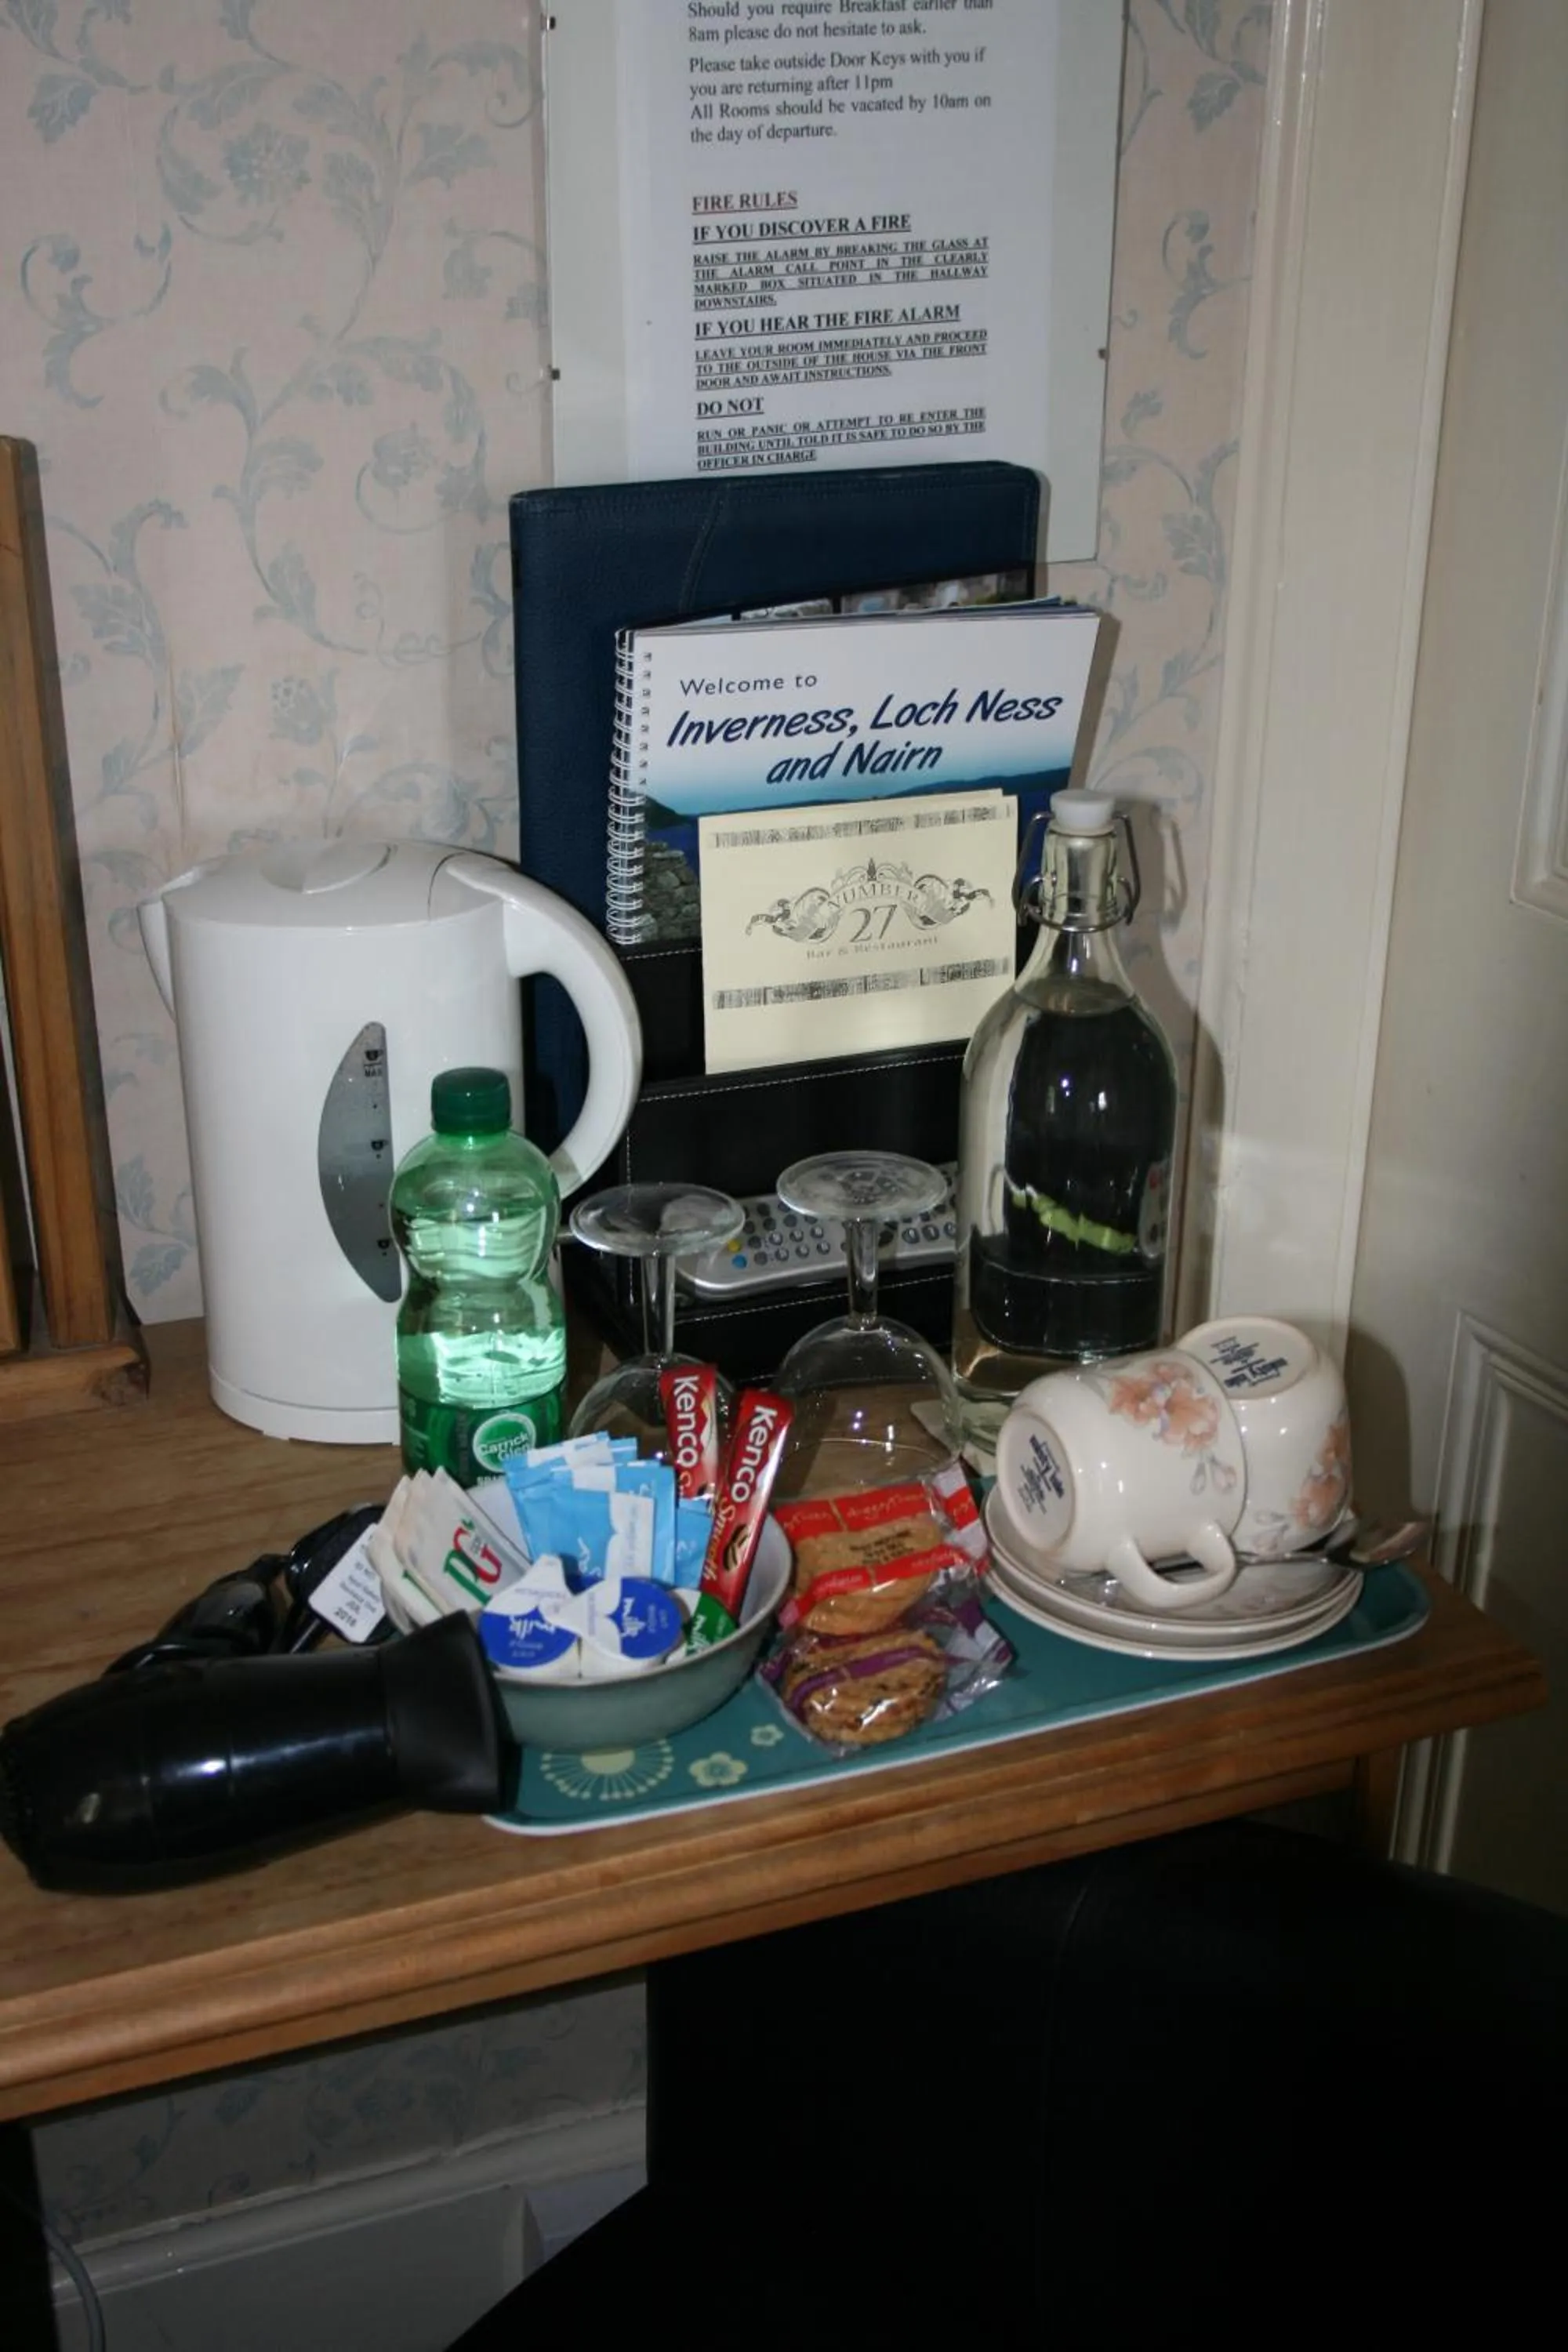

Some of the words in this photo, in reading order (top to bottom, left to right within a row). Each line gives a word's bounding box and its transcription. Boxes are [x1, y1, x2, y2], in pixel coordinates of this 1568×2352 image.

[688, 2, 739, 17] Should
[747, 4, 774, 20] you
[782, 1, 833, 19] require
[840, 0, 906, 13] Breakfast
[689, 26, 719, 42] 8am
[724, 25, 769, 44] please
[774, 24, 791, 38] do
[797, 24, 818, 38] not
[823, 21, 877, 37] hesitate
[881, 22, 895, 35] to
[899, 18, 927, 34] ask.
[690, 57, 735, 72] Please
[740, 55, 770, 71] take
[774, 53, 826, 69] outside
[830, 52, 866, 68] Door
[870, 50, 906, 70] Keys
[910, 47, 940, 64] with
[944, 51, 970, 67] you
[975, 46, 986, 62] if
[690, 84, 717, 100] you
[721, 83, 742, 95] are
[747, 78, 812, 96] returning
[817, 75, 849, 92] after
[855, 74, 893, 93] 11pm
[691, 103, 713, 119] All
[720, 103, 770, 118] Rooms
[775, 99, 822, 115] should
[829, 98, 845, 113] be
[851, 96, 903, 112] vacated
[909, 94, 927, 113] by
[933, 93, 969, 109] 10am
[975, 95, 991, 107] on
[690, 127, 713, 143] the
[717, 125, 743, 145] day
[747, 124, 764, 140] of
[766, 122, 837, 143] departure.
[692, 194, 734, 212] FIRE
[739, 191, 798, 209] RULES
[693, 224, 710, 241] IF
[716, 223, 753, 240] YOU
[759, 217, 849, 236] DISCOVER
[855, 217, 866, 232] A
[872, 213, 911, 231] FIRE
[693, 252, 728, 266] RAISE
[735, 251, 760, 263] THE
[767, 247, 809, 261] ALARM
[815, 246, 831, 259] BY
[837, 241, 897, 256] BREAKING
[902, 239, 927, 252] THE
[931, 238, 968, 251] GLASS
[975, 236, 989, 249] AT
[695, 268, 717, 281] THE
[730, 264, 775, 278] ALARM
[785, 261, 818, 274] CALL
[829, 258, 866, 273] POINT
[877, 256, 889, 269] IN
[901, 255, 923, 267] THE
[935, 252, 989, 266] CLEARLY
[695, 281, 748, 296] MARKED
[760, 278, 785, 292] BOX
[797, 274, 857, 289] SITUATED
[869, 272, 882, 285] IN
[896, 270, 918, 283] THE
[931, 266, 989, 280] HALLWAY
[695, 321, 712, 338] IF
[717, 318, 755, 336] YOU
[760, 315, 808, 333] HEAR
[814, 311, 849, 329] THE
[854, 308, 893, 326] FIRE
[898, 303, 960, 322] ALARM
[695, 347, 735, 361] LEAVE
[741, 343, 774, 358] YOUR
[778, 340, 815, 354] ROOM
[818, 335, 902, 352] IMMEDIATELY
[906, 332, 931, 346] AND
[935, 328, 988, 343] PROCEED
[696, 363, 713, 376] TO
[717, 361, 742, 374] THE
[747, 357, 798, 372] OUTSIDE
[804, 355, 819, 368] OF
[824, 353, 848, 367] THE
[852, 350, 891, 364] HOUSE
[896, 348, 916, 361] VIA
[922, 347, 944, 359] THE
[949, 343, 987, 357] FRONT
[696, 377, 730, 390] DOOR
[734, 375, 758, 387] AND
[762, 372, 800, 385] AWAIT
[696, 401, 722, 416] DO
[728, 396, 764, 413] NOT
[697, 430, 722, 442] RUN
[728, 426, 746, 439] OR
[752, 423, 786, 437] PANIC
[793, 421, 810, 434] OR
[817, 416, 871, 431] ATTEMPT
[879, 415, 893, 427] TO
[899, 412, 914, 425] RE
[920, 409, 957, 423] ENTER
[964, 407, 985, 419] THE
[698, 441, 754, 456] BUILDING
[759, 437, 794, 451] UNTIL
[797, 434, 829, 448] TOLD
[846, 430, 857, 443] IS
[859, 428, 886, 441] SAFE
[891, 426, 906, 440] TO
[909, 425, 925, 437] DO
[928, 423, 942, 436] SO
[946, 422, 959, 434] BY
[964, 420, 985, 433] THE
[698, 456, 749, 470] OFFICER
[753, 454, 764, 466] IN
[768, 449, 817, 464] CHARGE
[680, 675, 785, 697] Welcome
[796, 673, 818, 688] to
[666, 705, 858, 747] Inverness,
[869, 688, 958, 730] Loch
[965, 688, 1063, 724] Ness
[766, 742, 842, 784] and
[841, 740, 942, 779] Nairn
[829, 883, 919, 908] NUMBER
[850, 904, 898, 942] 27
[673, 1375, 700, 1468] Kenco
[731, 1404, 779, 1503] Kenco
